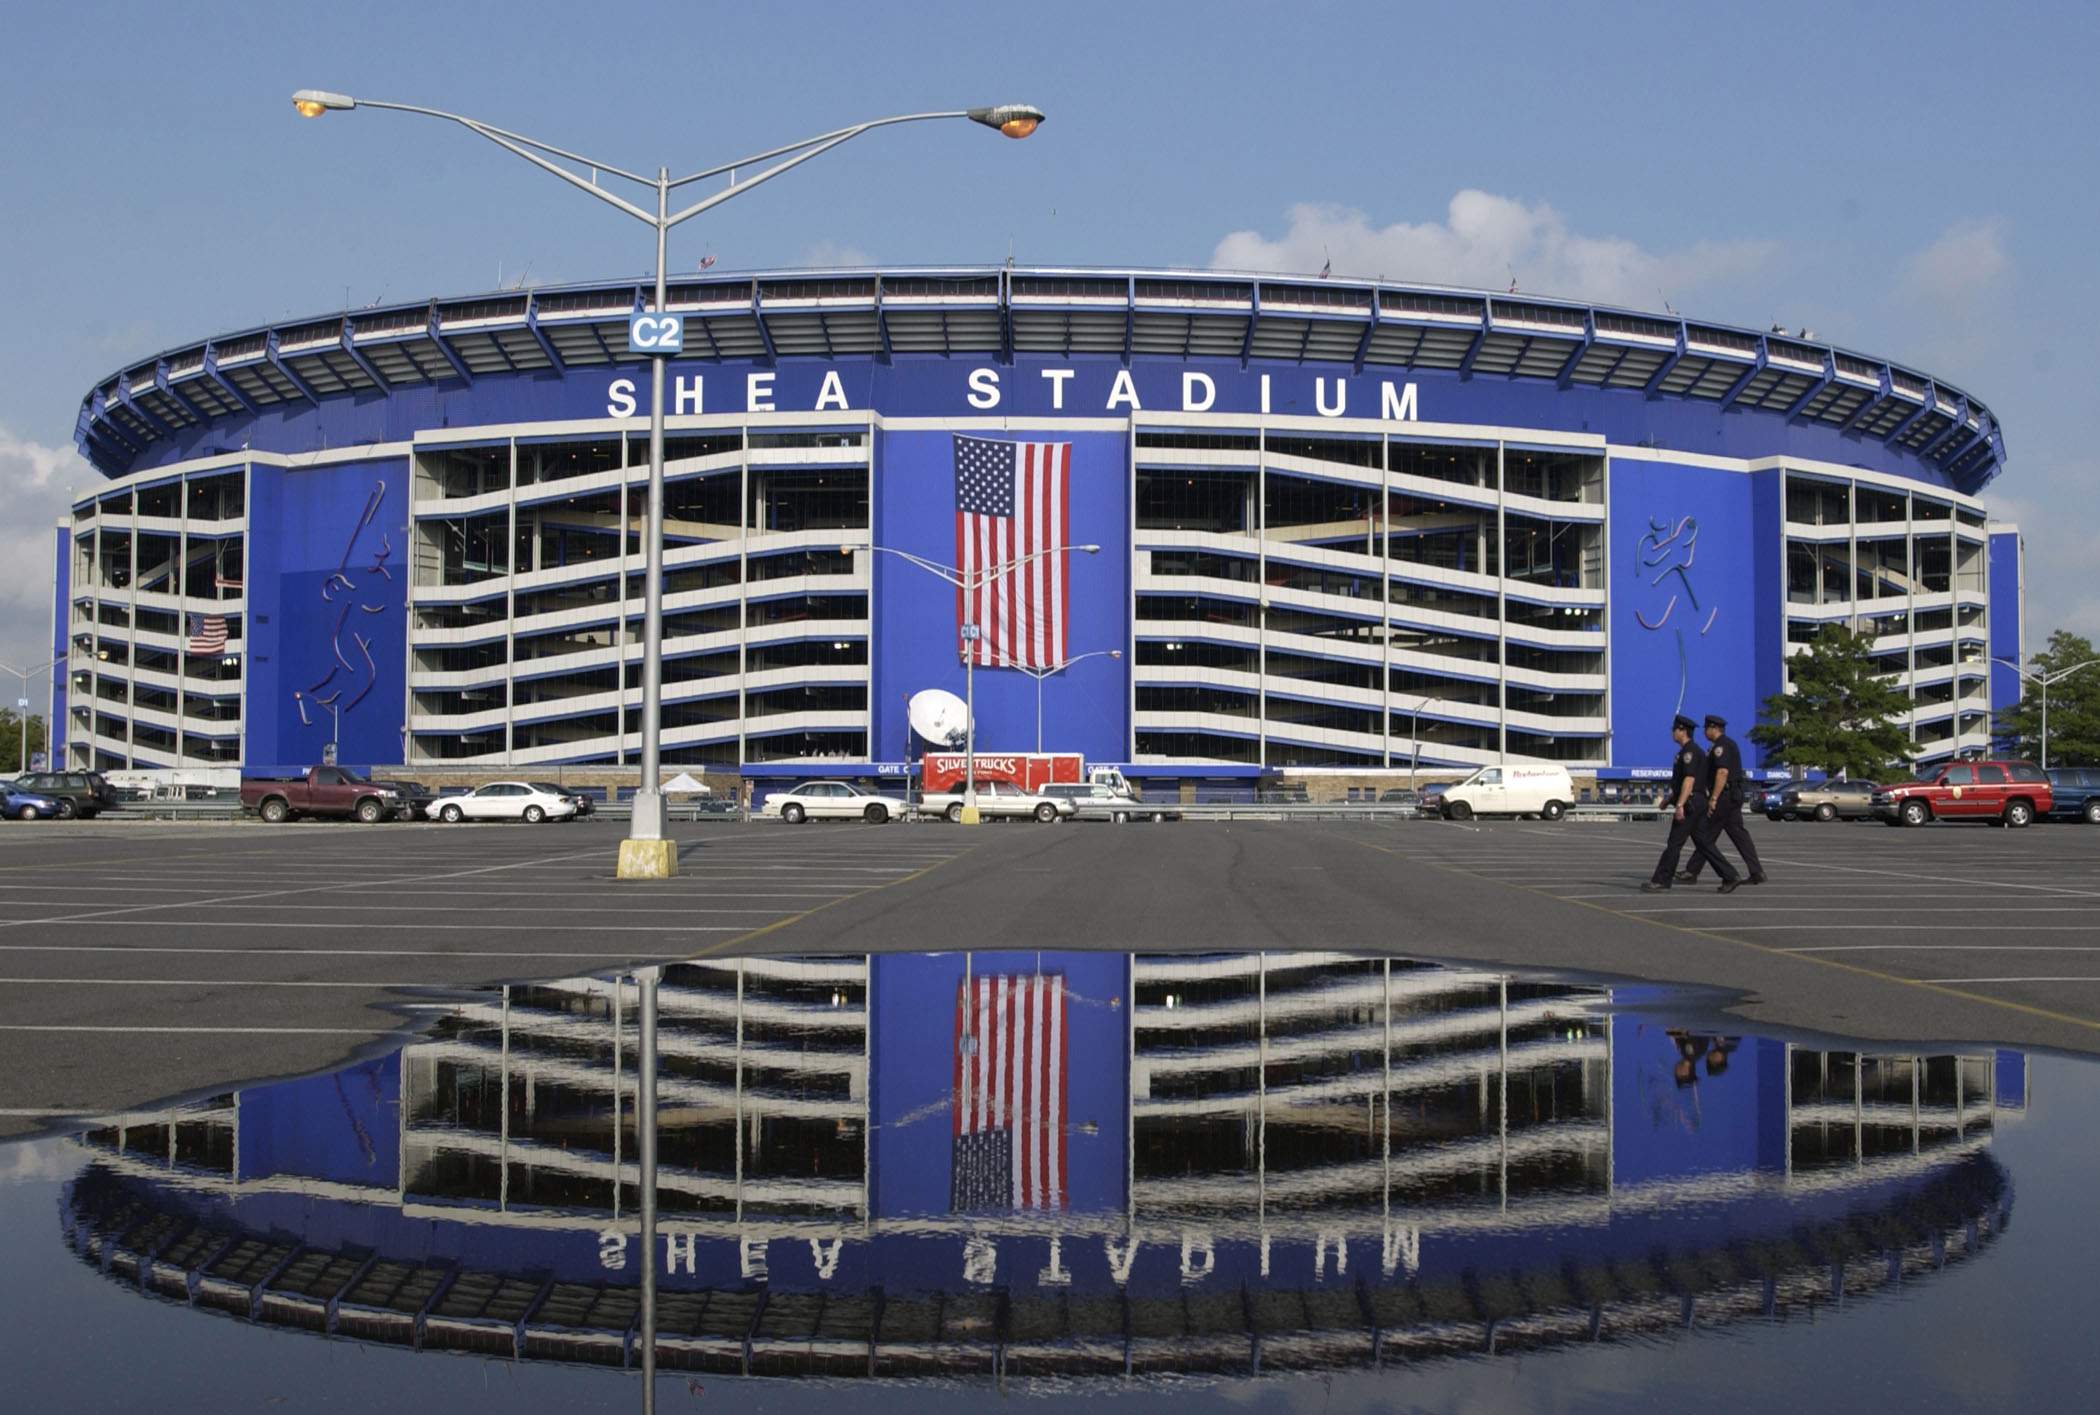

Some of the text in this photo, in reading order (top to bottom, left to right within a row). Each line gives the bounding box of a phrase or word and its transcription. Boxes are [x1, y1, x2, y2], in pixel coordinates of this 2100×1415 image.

[632, 317, 680, 348] C2
[607, 368, 1418, 421] SHEA STADIUM
[878, 765, 900, 774] GATE
[937, 758, 972, 774] SILVE
